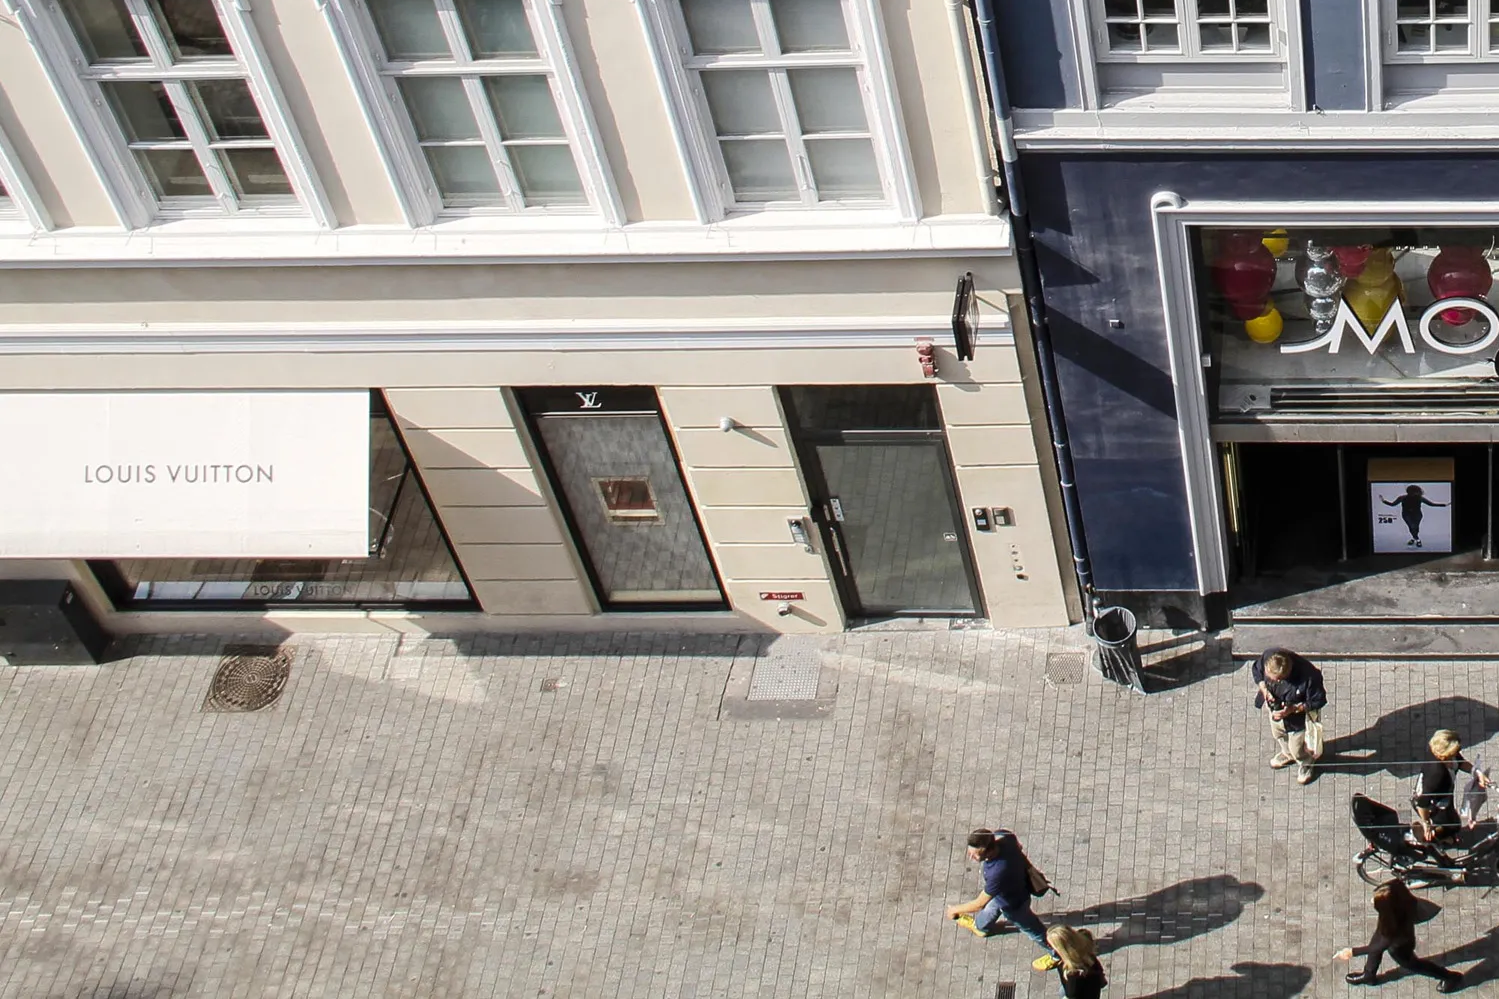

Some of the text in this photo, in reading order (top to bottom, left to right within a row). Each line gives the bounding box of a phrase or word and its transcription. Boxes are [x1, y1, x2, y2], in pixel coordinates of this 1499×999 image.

[85, 465, 273, 483] LOUIS VUITTON
[254, 585, 292, 596] LOUIS
